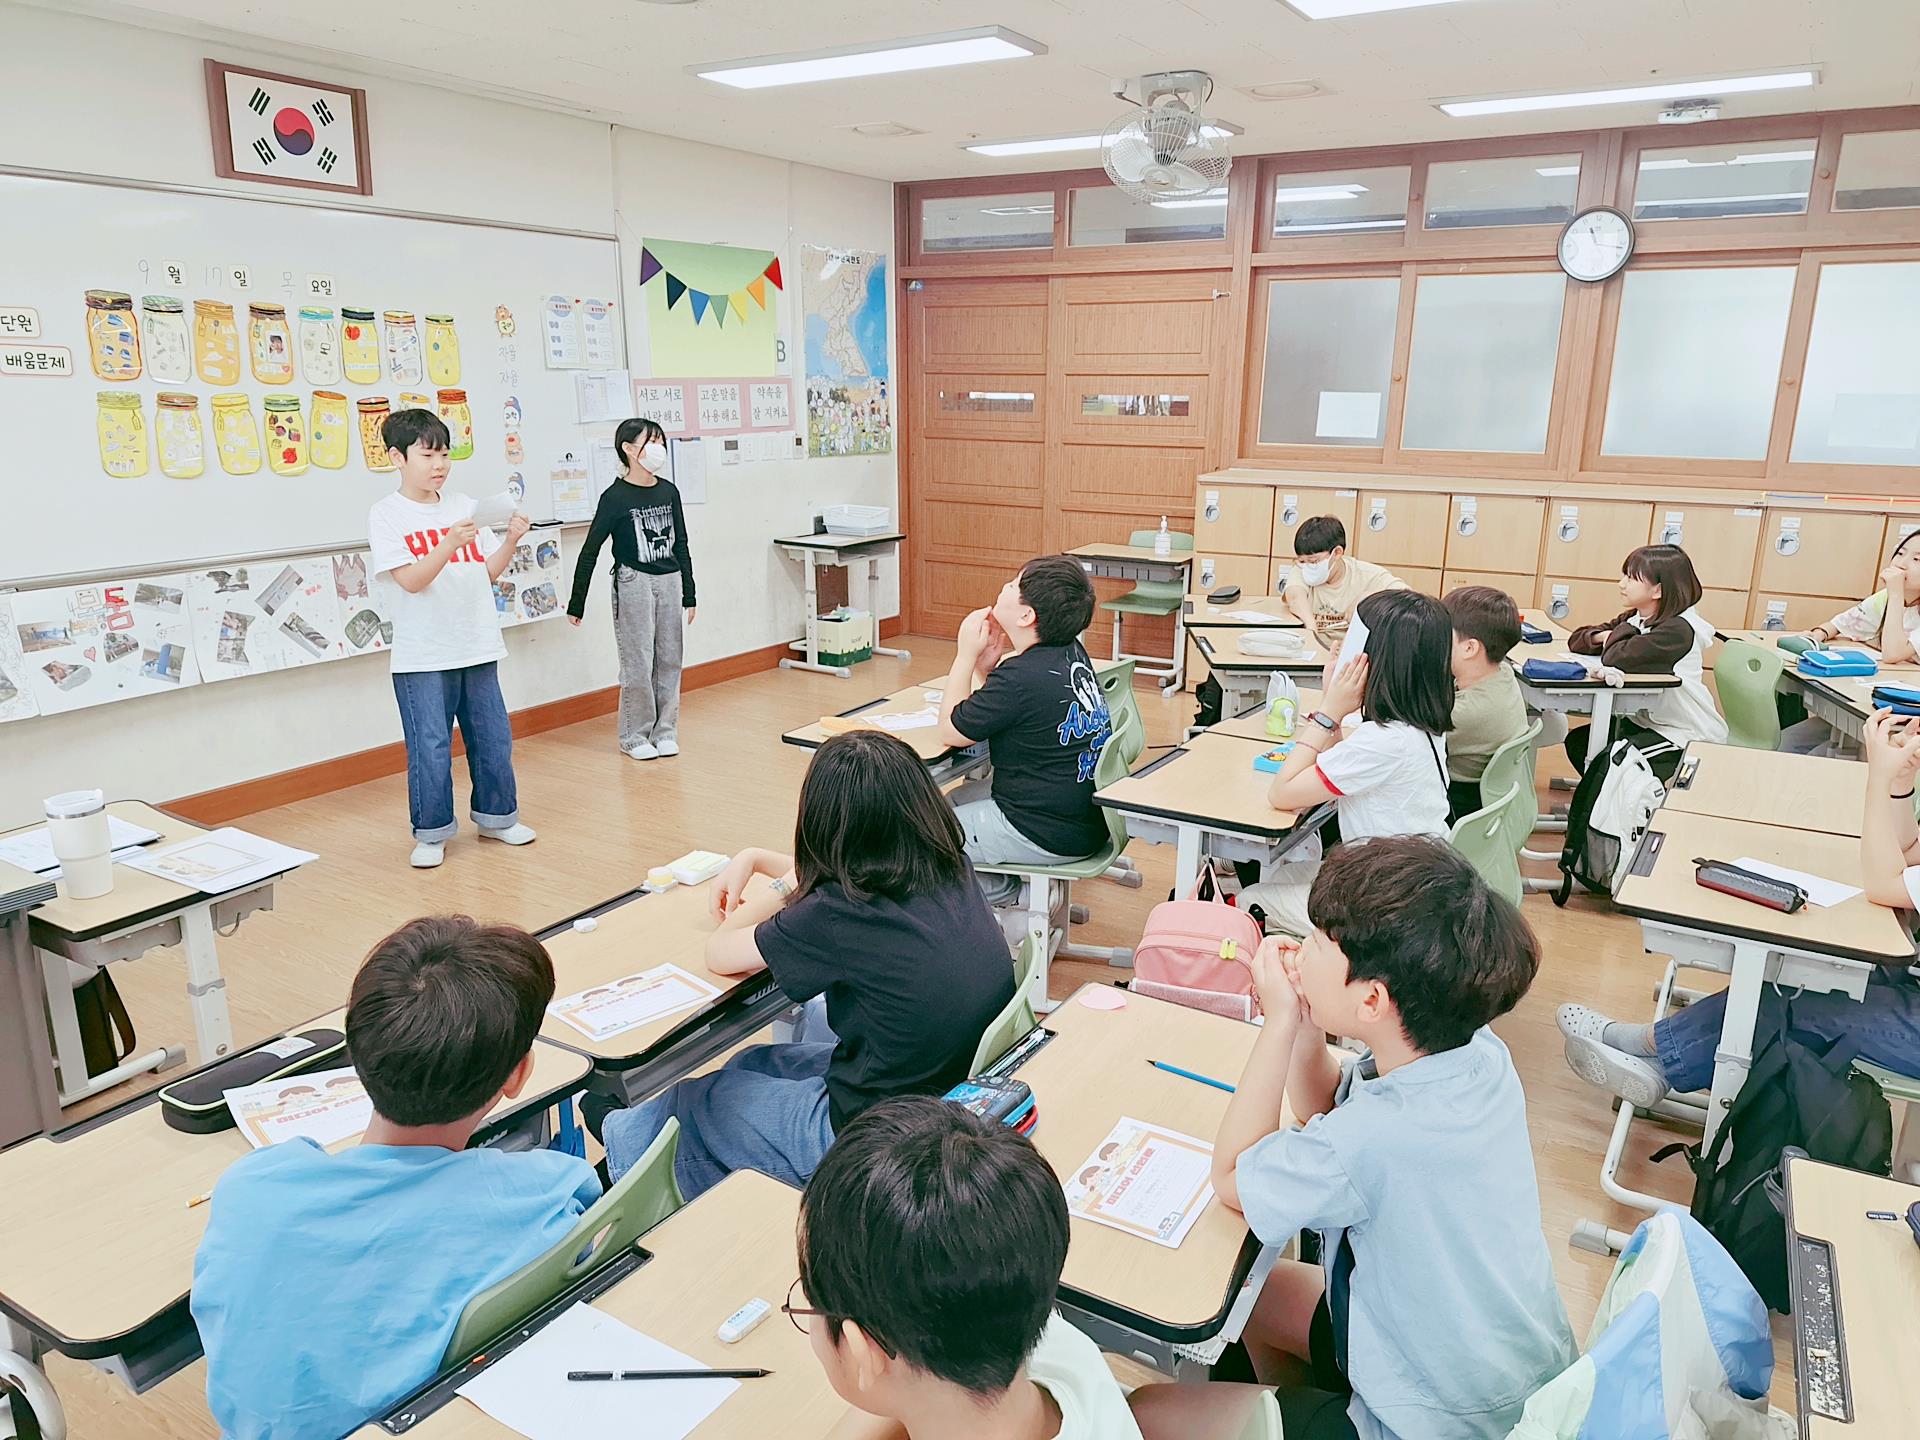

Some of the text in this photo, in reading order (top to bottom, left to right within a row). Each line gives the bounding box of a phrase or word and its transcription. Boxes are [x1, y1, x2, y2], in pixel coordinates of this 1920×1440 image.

[138, 259, 332, 299] 9 월 17 일 목 요일
[0, 314, 33, 332] 단원
[776, 340, 786, 362] B
[5, 351, 65, 370] 배움문제
[639, 387, 683, 402] 서로 서로
[701, 387, 738, 401] 고운말을
[756, 386, 783, 400] 약속을
[641, 409, 683, 424] 사랑해요
[702, 407, 739, 423] 사용해요
[752, 406, 788, 420] 잘 지켜요
[276, 1105, 330, 1124] 미디어
[1106, 1176, 1135, 1206] 미디어
